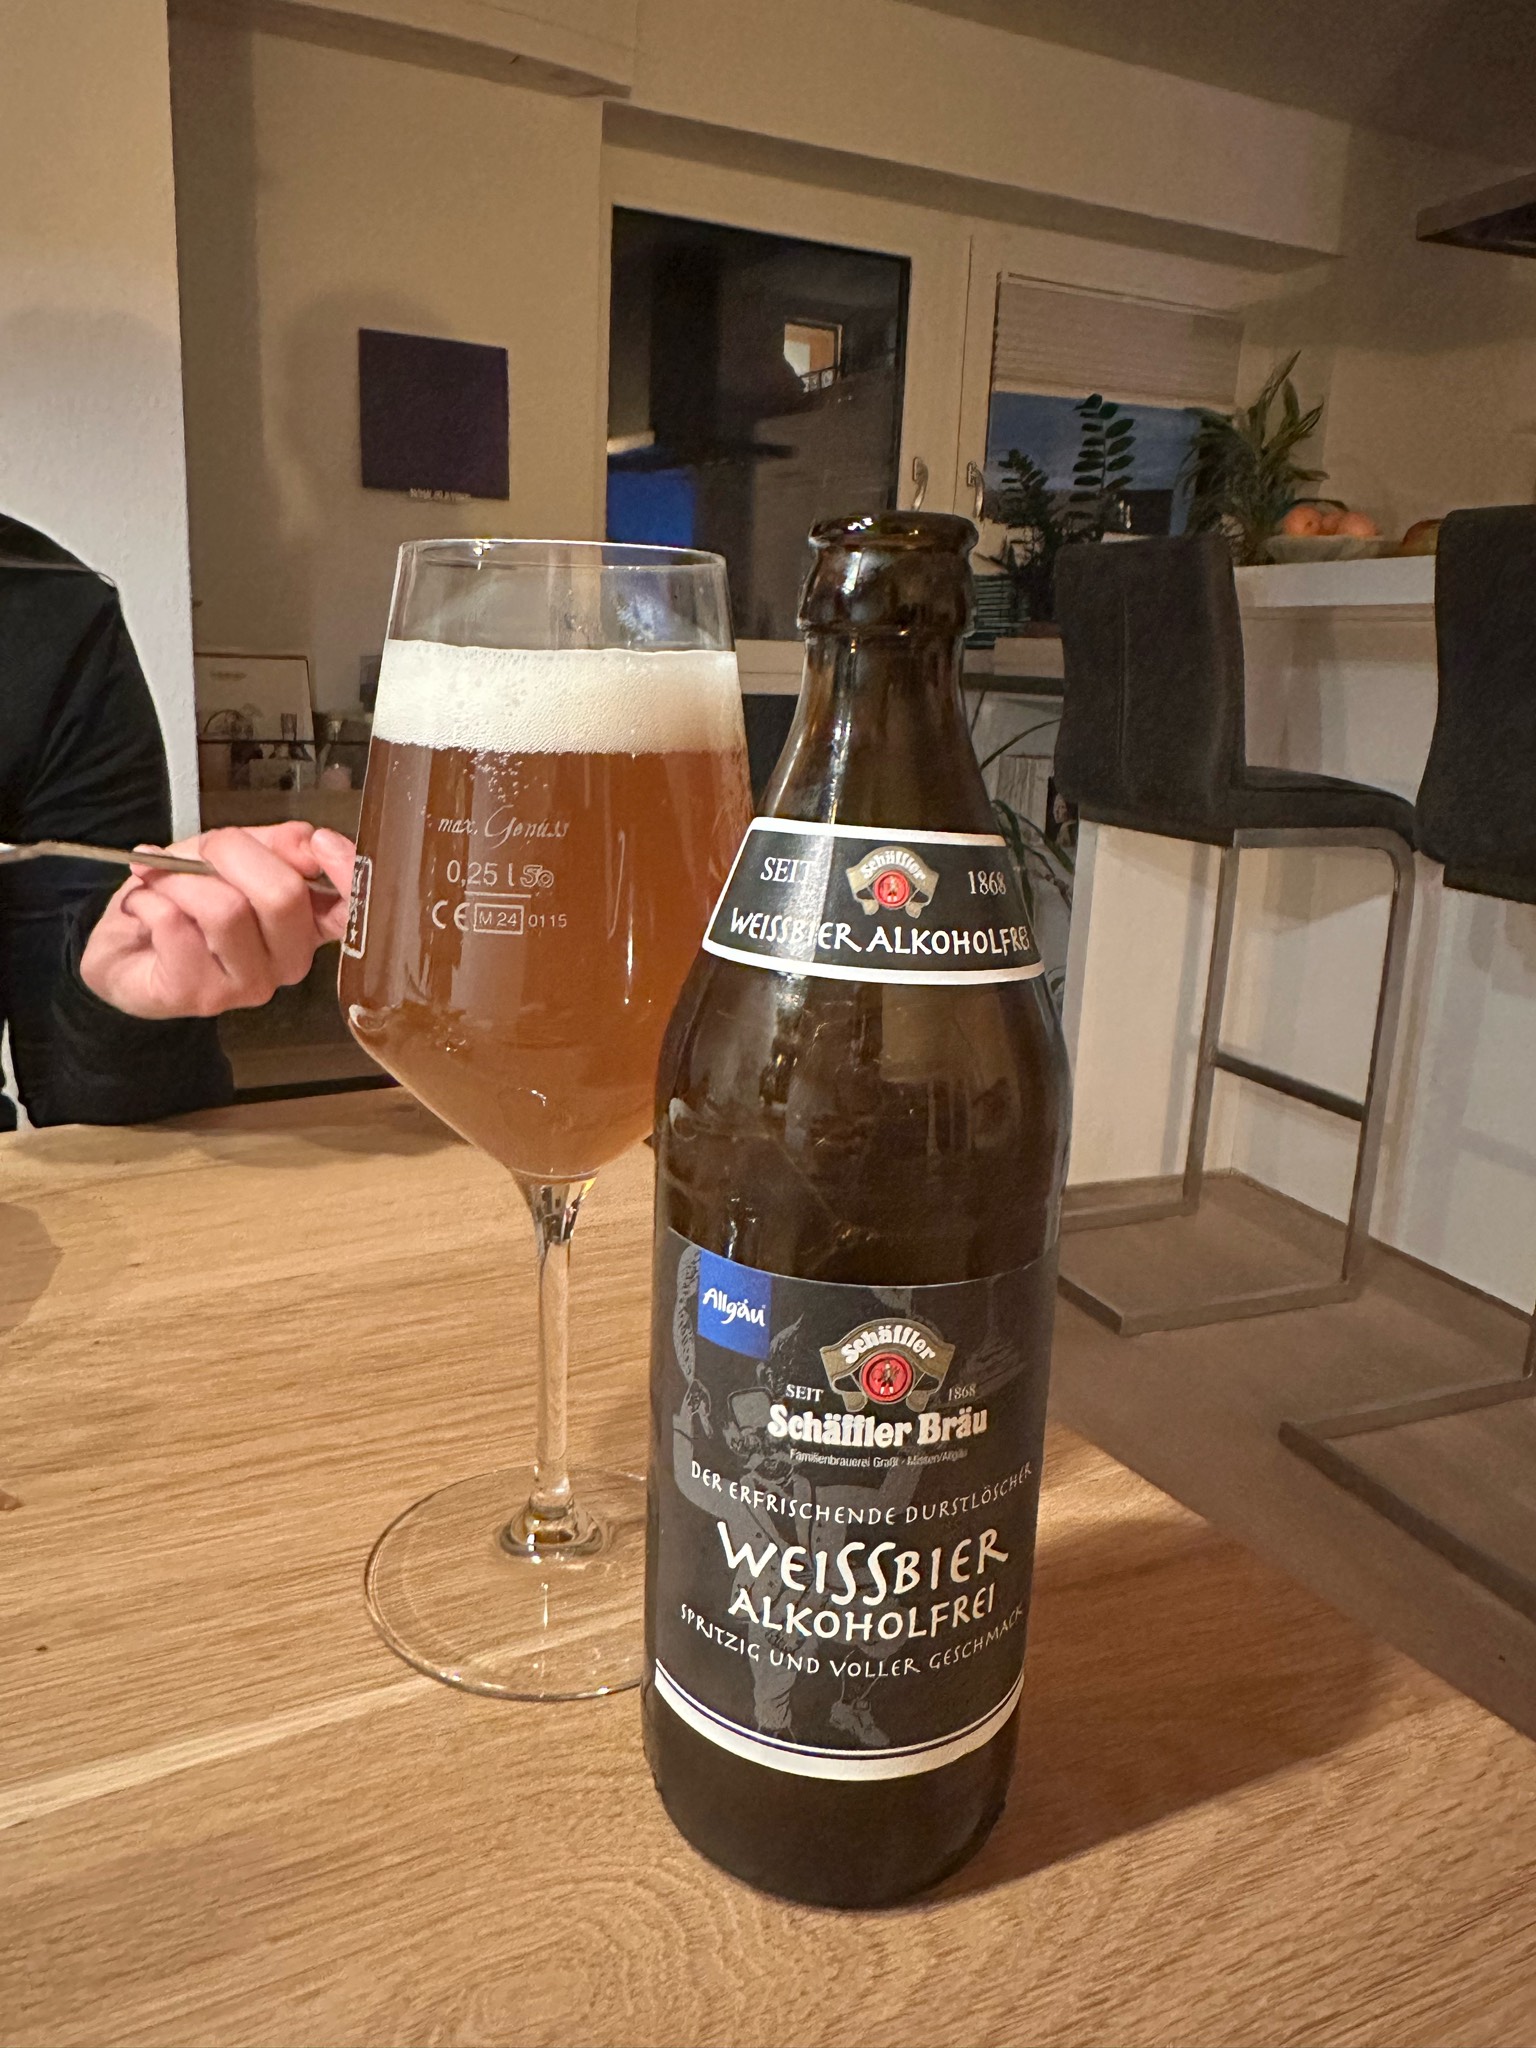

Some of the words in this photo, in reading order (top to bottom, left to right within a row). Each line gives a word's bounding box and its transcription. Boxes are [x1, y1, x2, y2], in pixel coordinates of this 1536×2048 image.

[437, 817, 479, 836] max.
[446, 859, 499, 887] 0,25
[760, 856, 815, 883] SEIT
[967, 870, 1007, 896] 1868
[527, 913, 568, 929] 0115
[730, 906, 863, 953] WEISSBIER
[702, 1287, 767, 1328] Allgäu
[840, 1324, 937, 1365] Schäffler
[785, 1383, 825, 1403] SEIT
[947, 1383, 978, 1402] 1868
[767, 1403, 914, 1449] Schäffler
[916, 1406, 990, 1446] Bräu
[691, 1460, 723, 1493] DER
[729, 1485, 896, 1526] ERFRISCHENDE
[905, 1460, 1032, 1525] DURSTLÖSCHER
[716, 1520, 1009, 1607] WEISSBIER
[727, 1581, 997, 1642] ALKOHOLFREI
[680, 1602, 761, 1662] SPRITZIG
[769, 1650, 821, 1676] UND
[829, 1657, 921, 1678] VOLLER
[928, 1600, 1024, 1670] GESCHMACK
